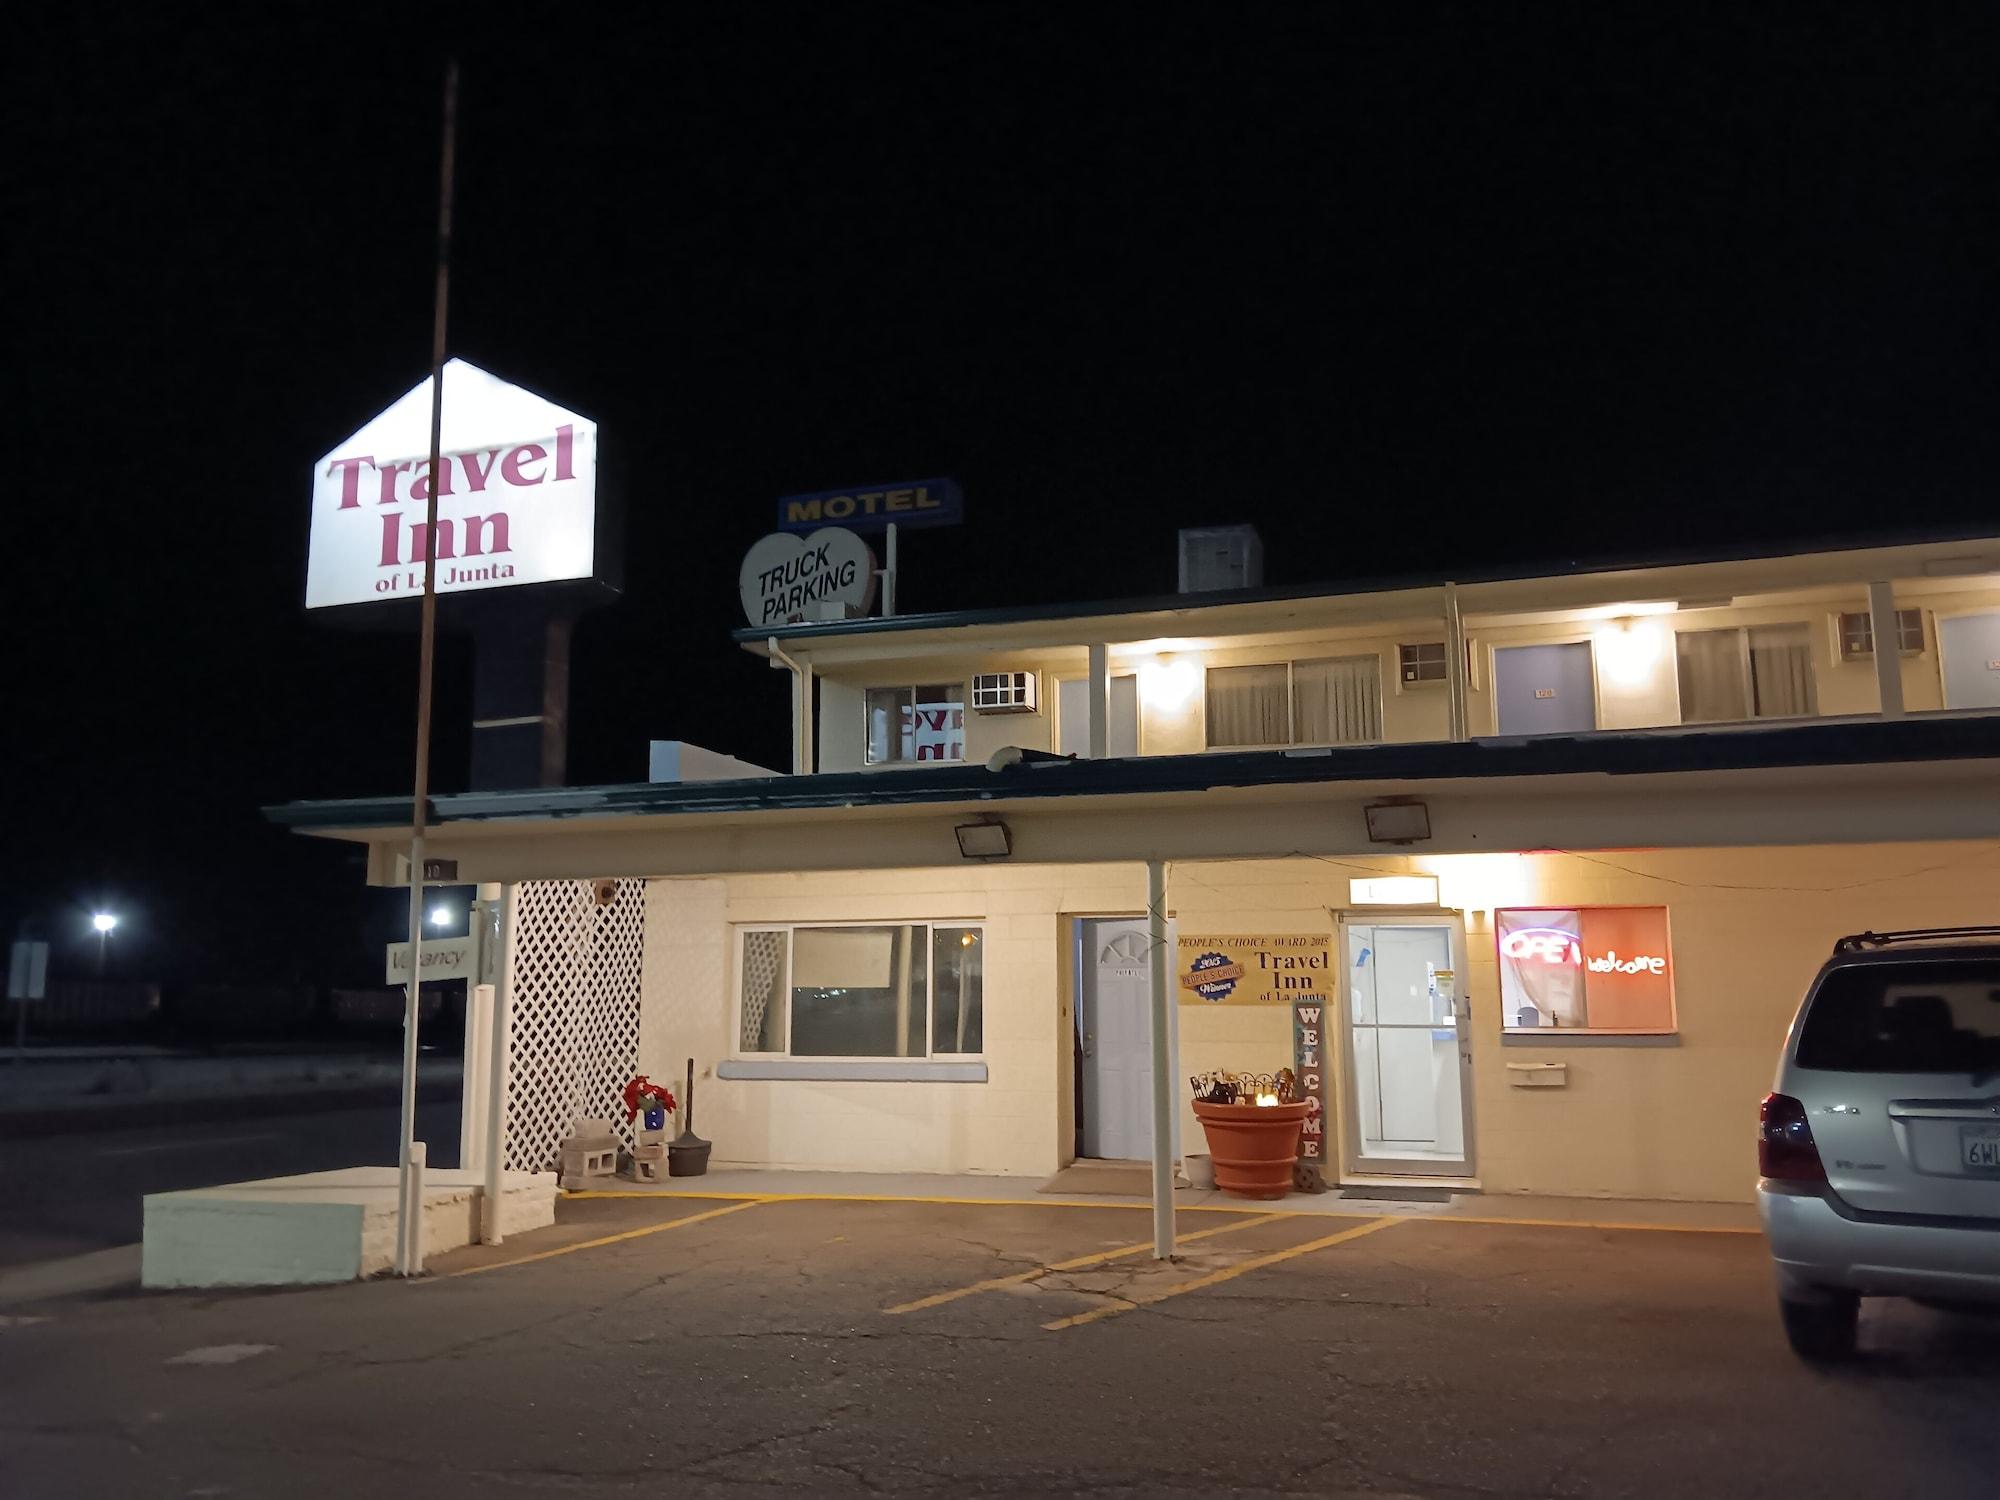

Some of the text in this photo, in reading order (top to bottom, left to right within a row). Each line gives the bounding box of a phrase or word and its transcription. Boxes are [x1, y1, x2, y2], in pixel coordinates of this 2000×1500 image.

[330, 424, 576, 510] Travel
[787, 488, 941, 522] MOTEL
[377, 511, 513, 567] Inn
[375, 562, 515, 593] of L Junta
[758, 542, 831, 597] TRUCK
[762, 560, 856, 624] PARKING
[1178, 938, 1223, 947] PEOPLE'S
[1228, 938, 1267, 947] CHOICE
[1255, 951, 1328, 969] Travel
[1260, 992, 1327, 1001] of La Junta
[1273, 972, 1313, 989] Inn
[1298, 1007, 1321, 1158] WELCOME
